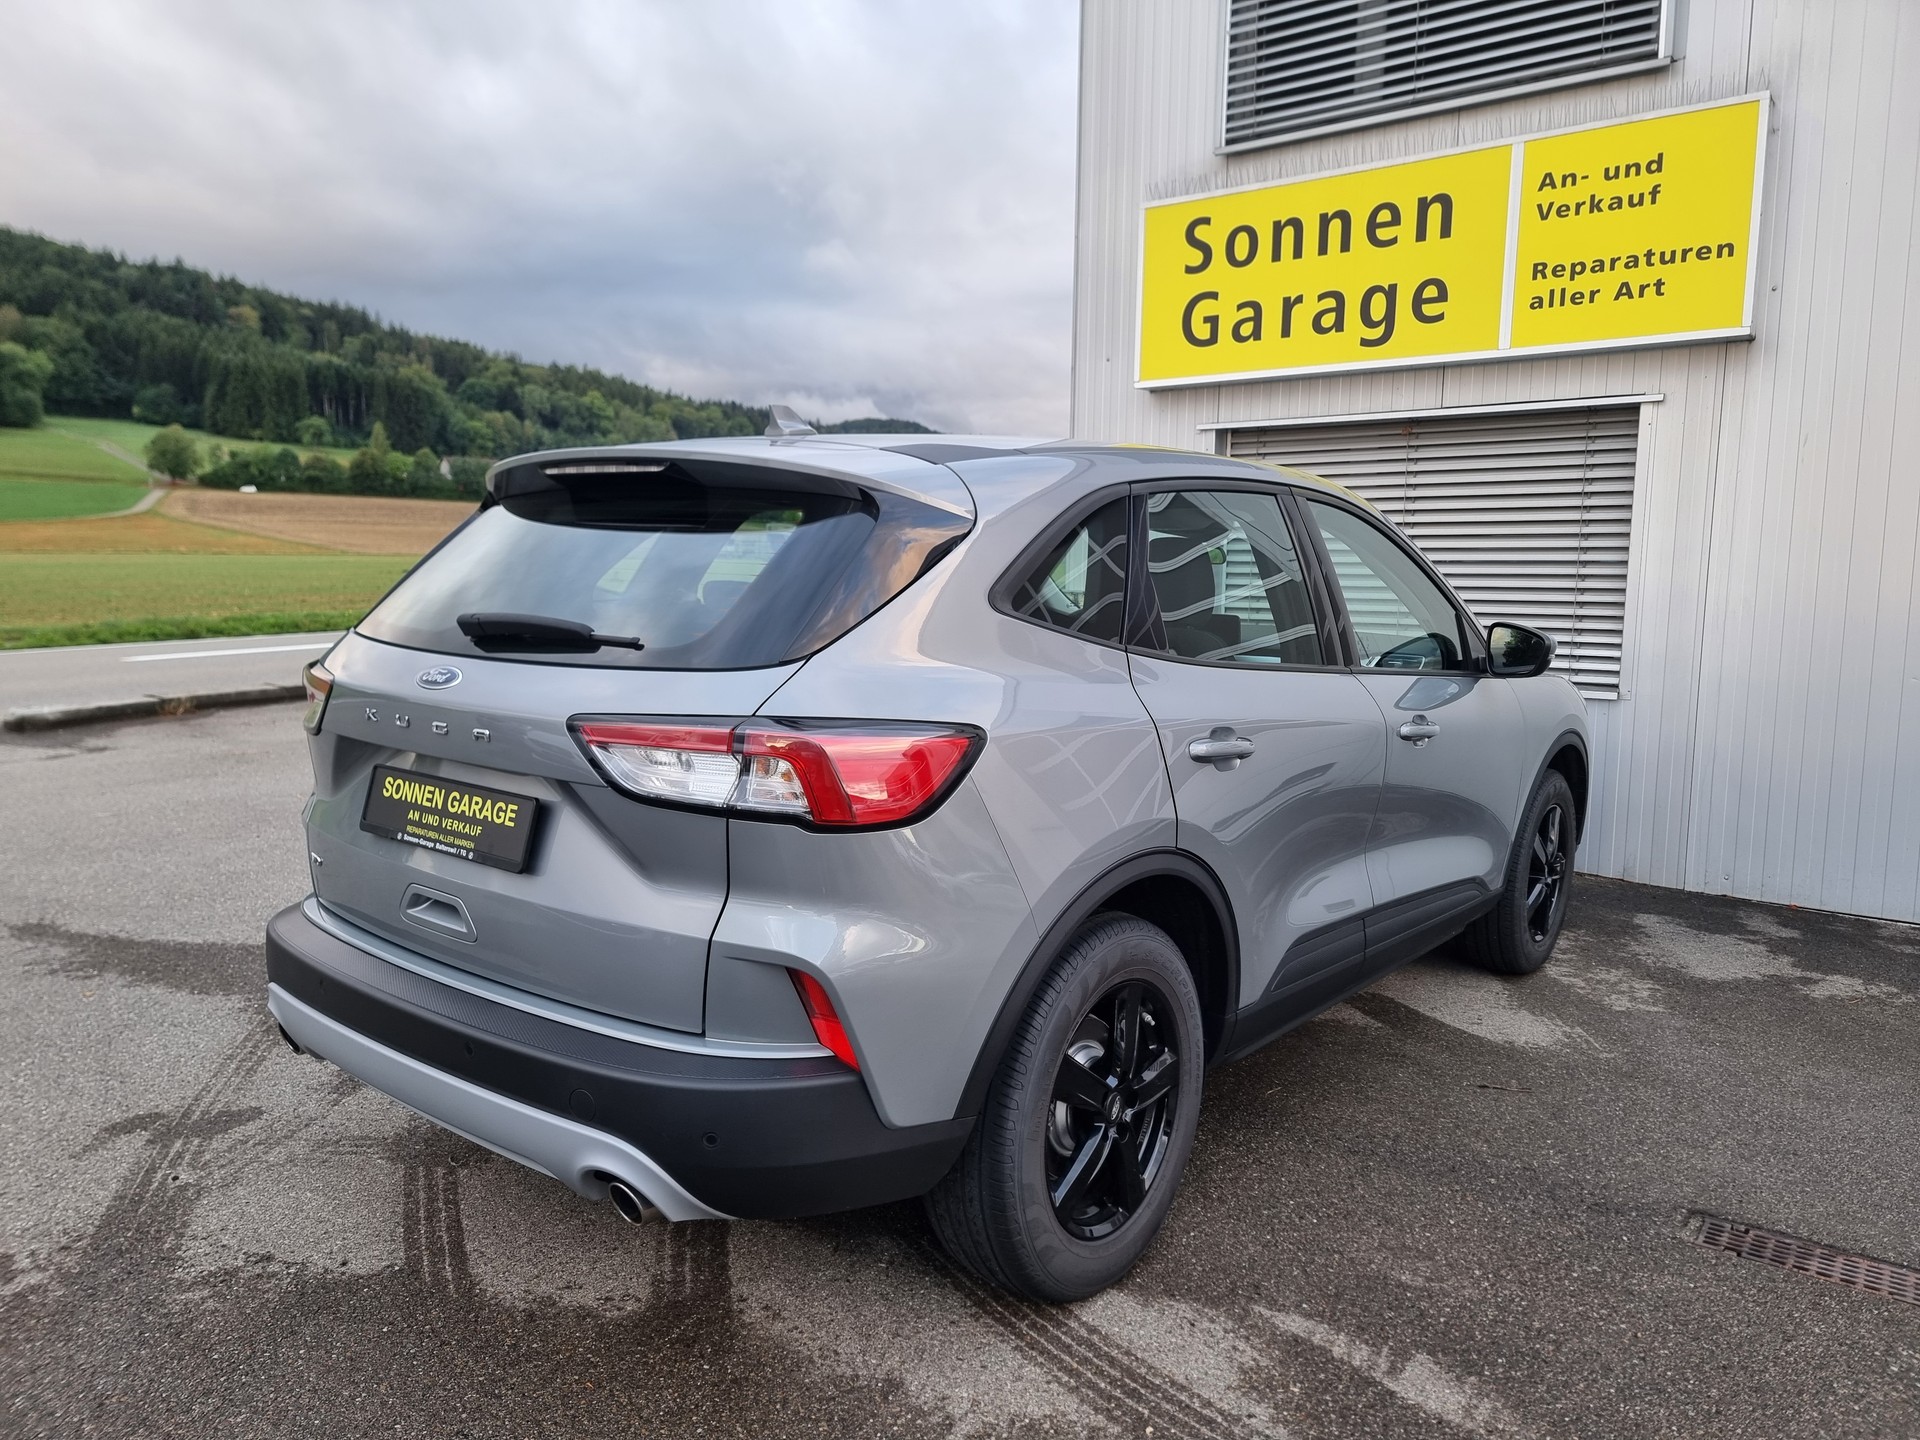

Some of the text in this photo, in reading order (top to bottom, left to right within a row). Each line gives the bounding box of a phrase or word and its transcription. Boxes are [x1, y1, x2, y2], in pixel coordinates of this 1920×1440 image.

[1537, 151, 1664, 193] An- und
[1536, 183, 1662, 222] Verkauf
[1184, 192, 1454, 275] Sonnen
[1531, 242, 1735, 282] Reparaturen
[1181, 277, 1449, 348] Garage
[1529, 277, 1666, 311] aller Art
[422, 668, 451, 683] Ford
[365, 707, 491, 742] KUGA
[382, 776, 519, 827] SONNEN GARAGE
[406, 825, 476, 849] REPARATUREN ALLER MARKEN
[407, 809, 483, 837] AN UND VERKAUF
